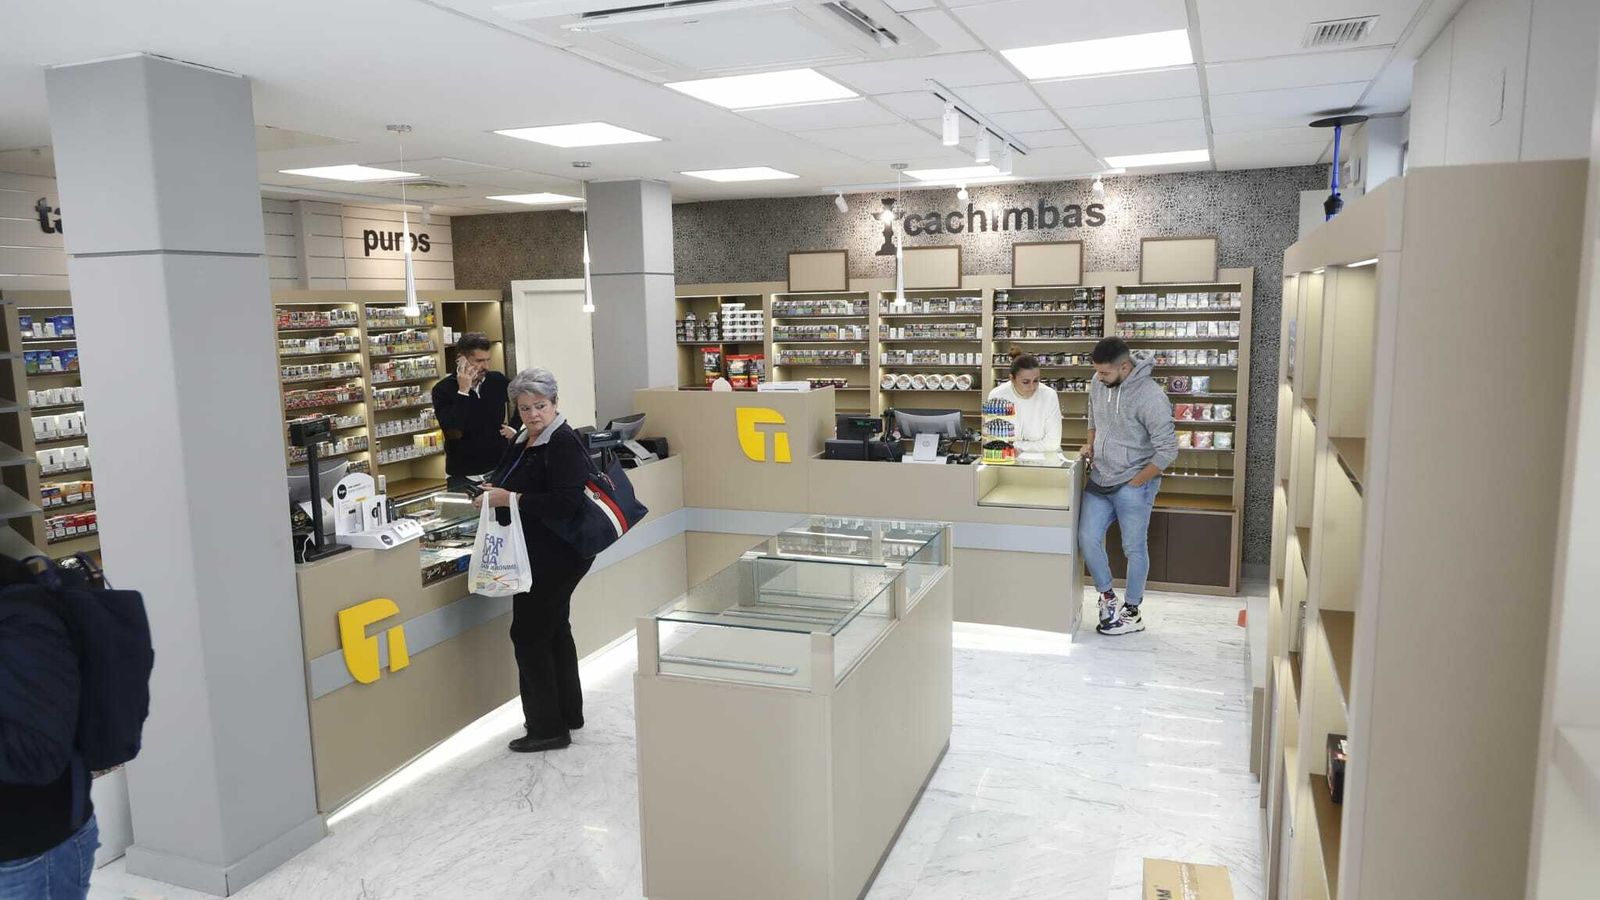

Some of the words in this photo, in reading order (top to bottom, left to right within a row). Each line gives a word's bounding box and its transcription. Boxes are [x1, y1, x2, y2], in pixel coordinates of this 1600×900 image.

[903, 202, 1106, 236] cachimbas
[363, 229, 431, 256] puros
[482, 544, 499, 556] MA
[485, 533, 504, 548] FAR
